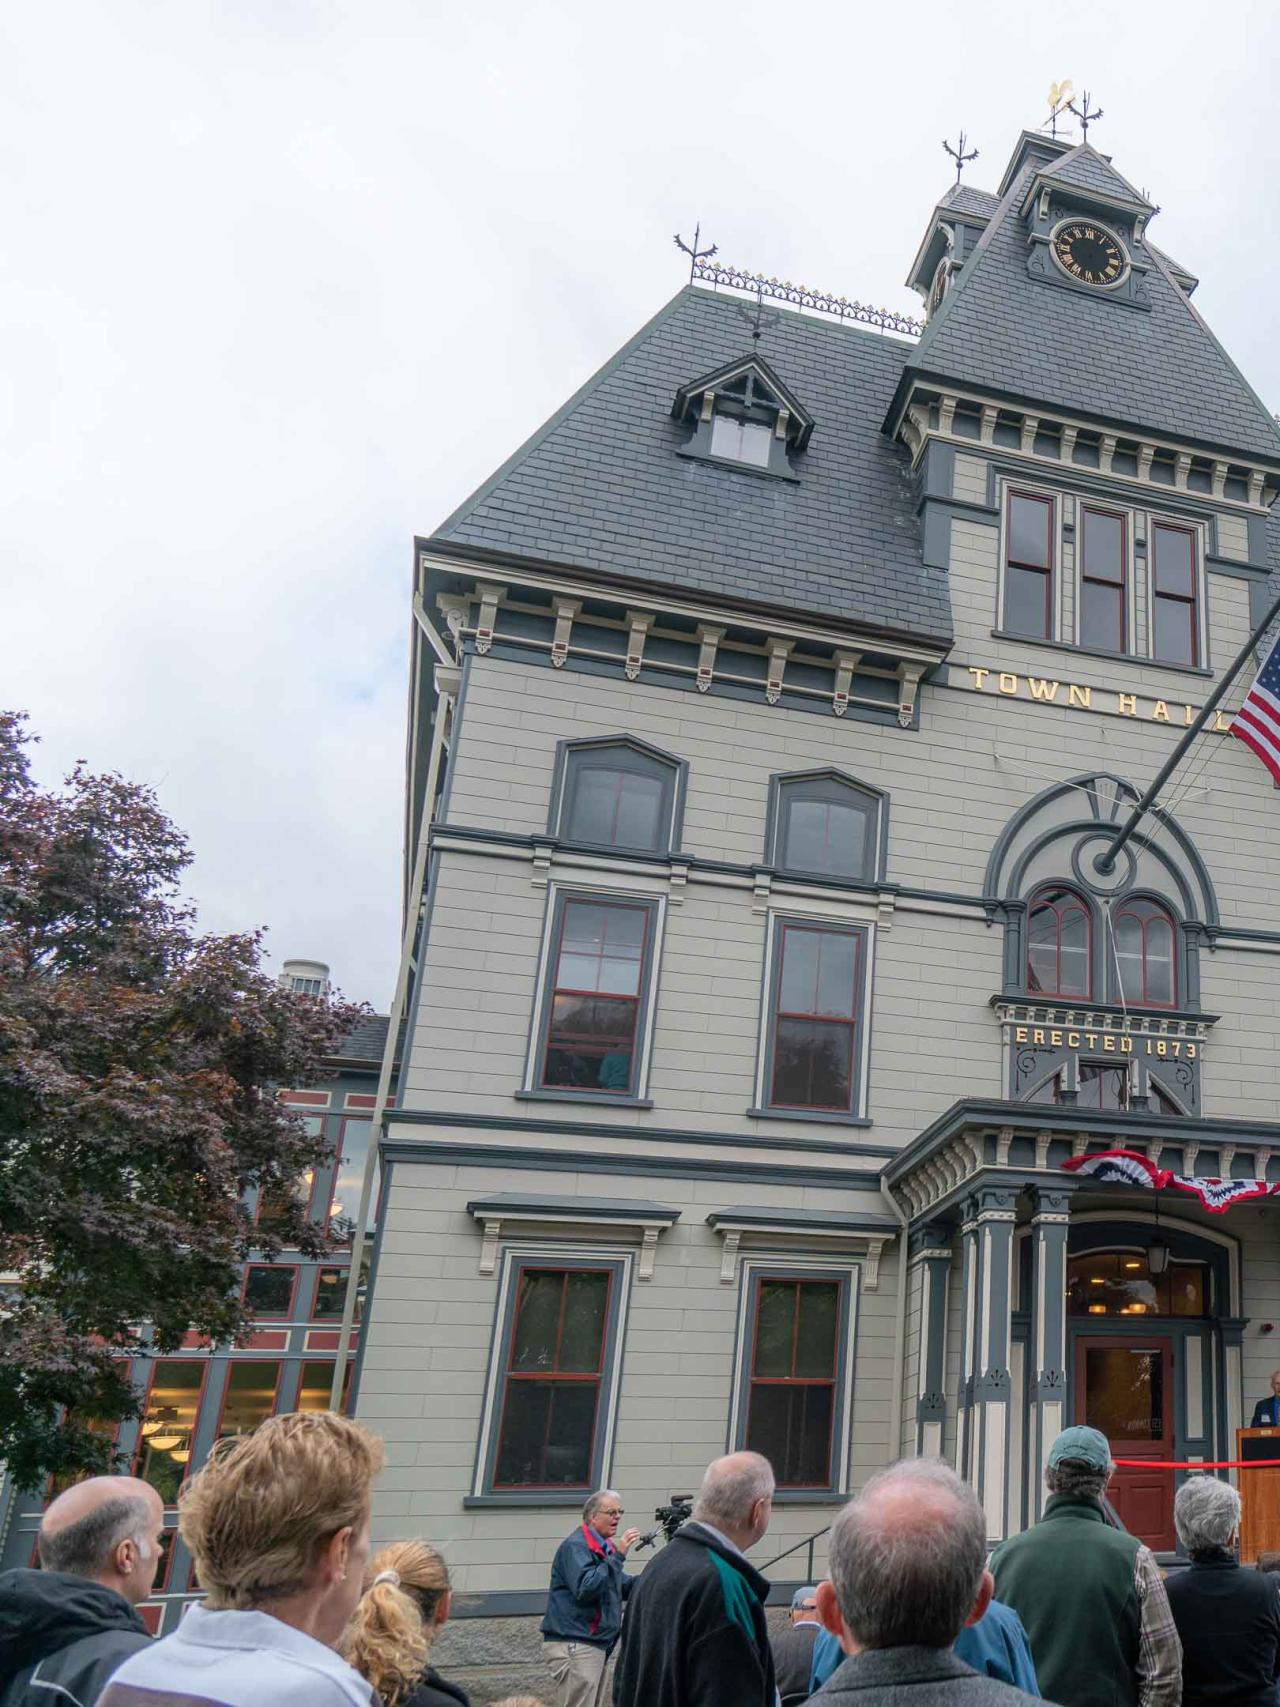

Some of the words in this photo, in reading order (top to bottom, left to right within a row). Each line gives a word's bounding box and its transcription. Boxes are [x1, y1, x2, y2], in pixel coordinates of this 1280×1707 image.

[968, 667, 1091, 708] TOWN
[1118, 692, 1231, 732] HALL
[1016, 1027, 1132, 1054] ERECTED
[1146, 1039, 1196, 1059] 1873
